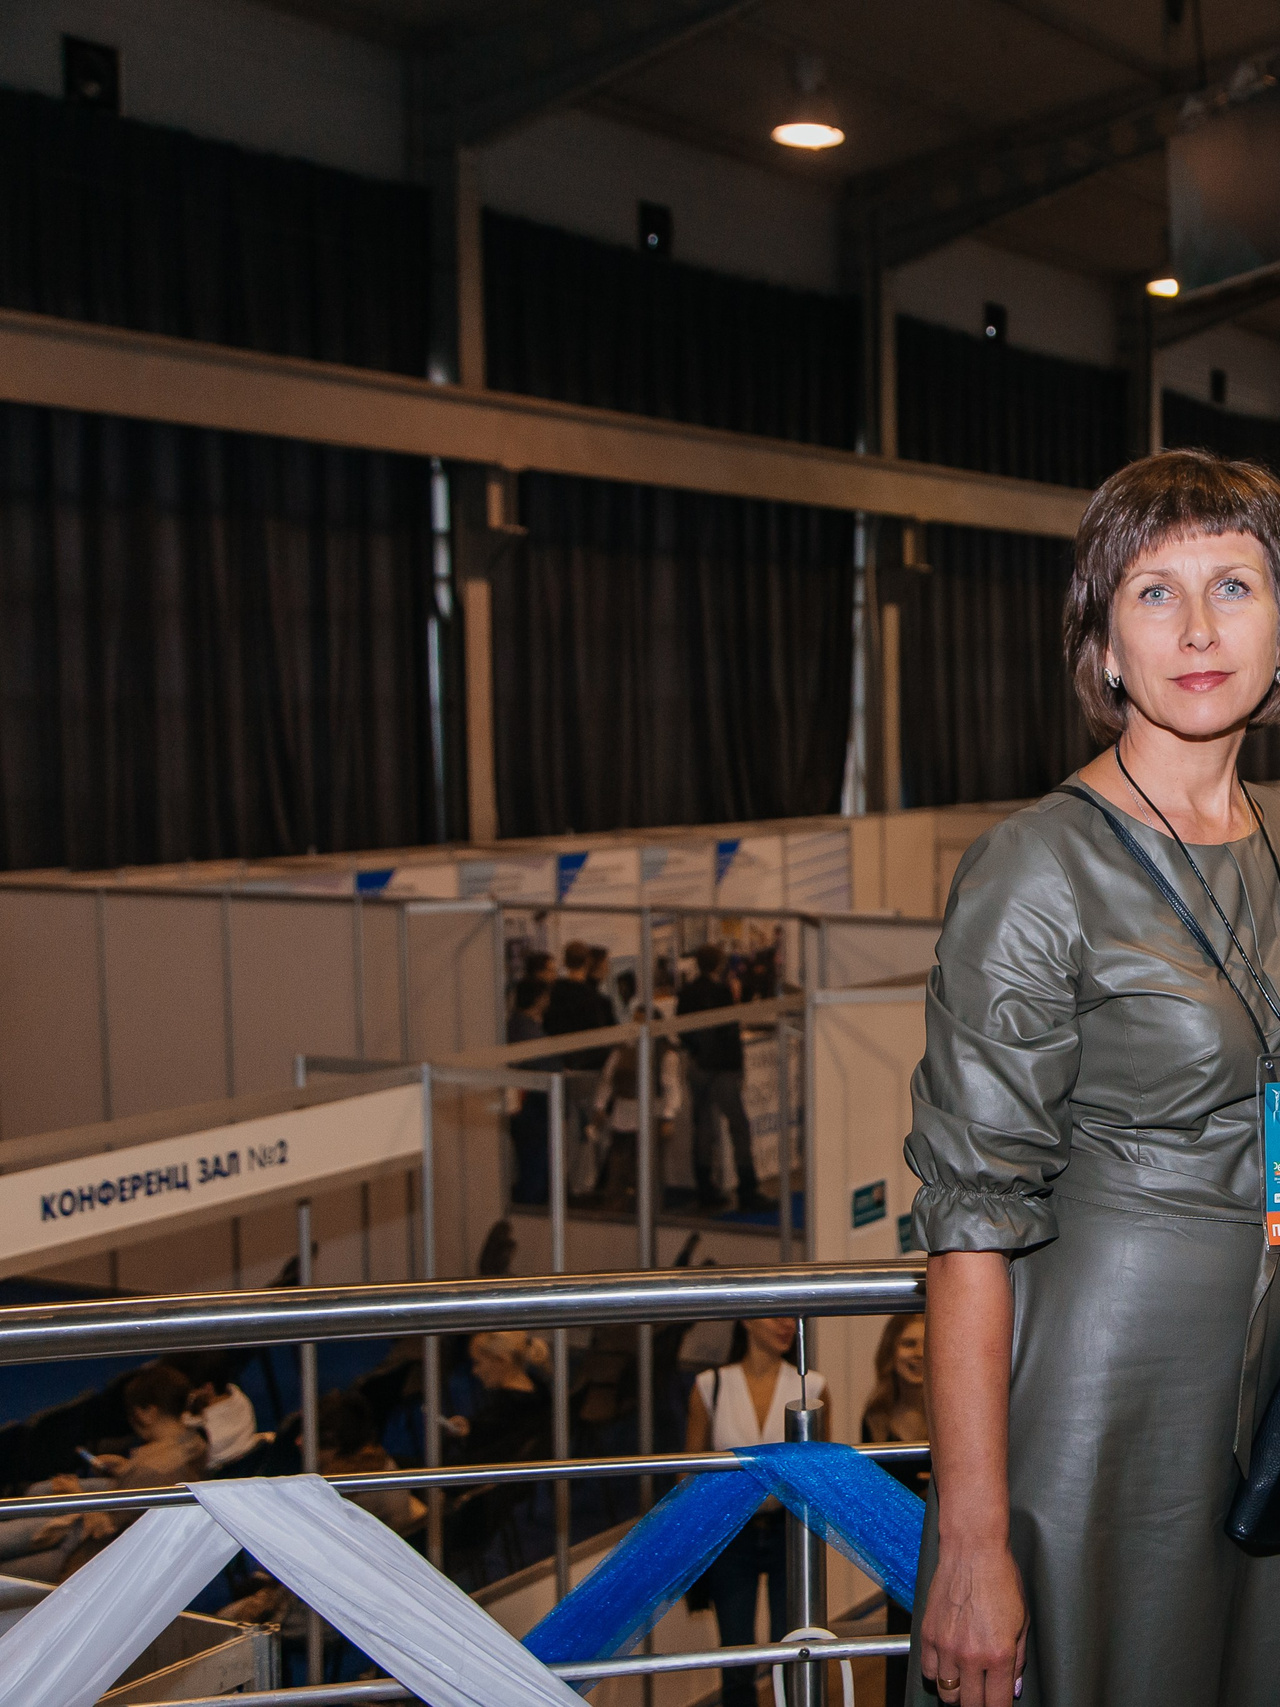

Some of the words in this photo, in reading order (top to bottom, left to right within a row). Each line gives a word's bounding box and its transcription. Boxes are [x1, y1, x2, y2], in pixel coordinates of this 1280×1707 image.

[40, 1162, 190, 1222] КОНФЕРЕНЦ
[197, 1151, 240, 1185] ЗАЛ
[248, 1139, 289, 1168] №2
